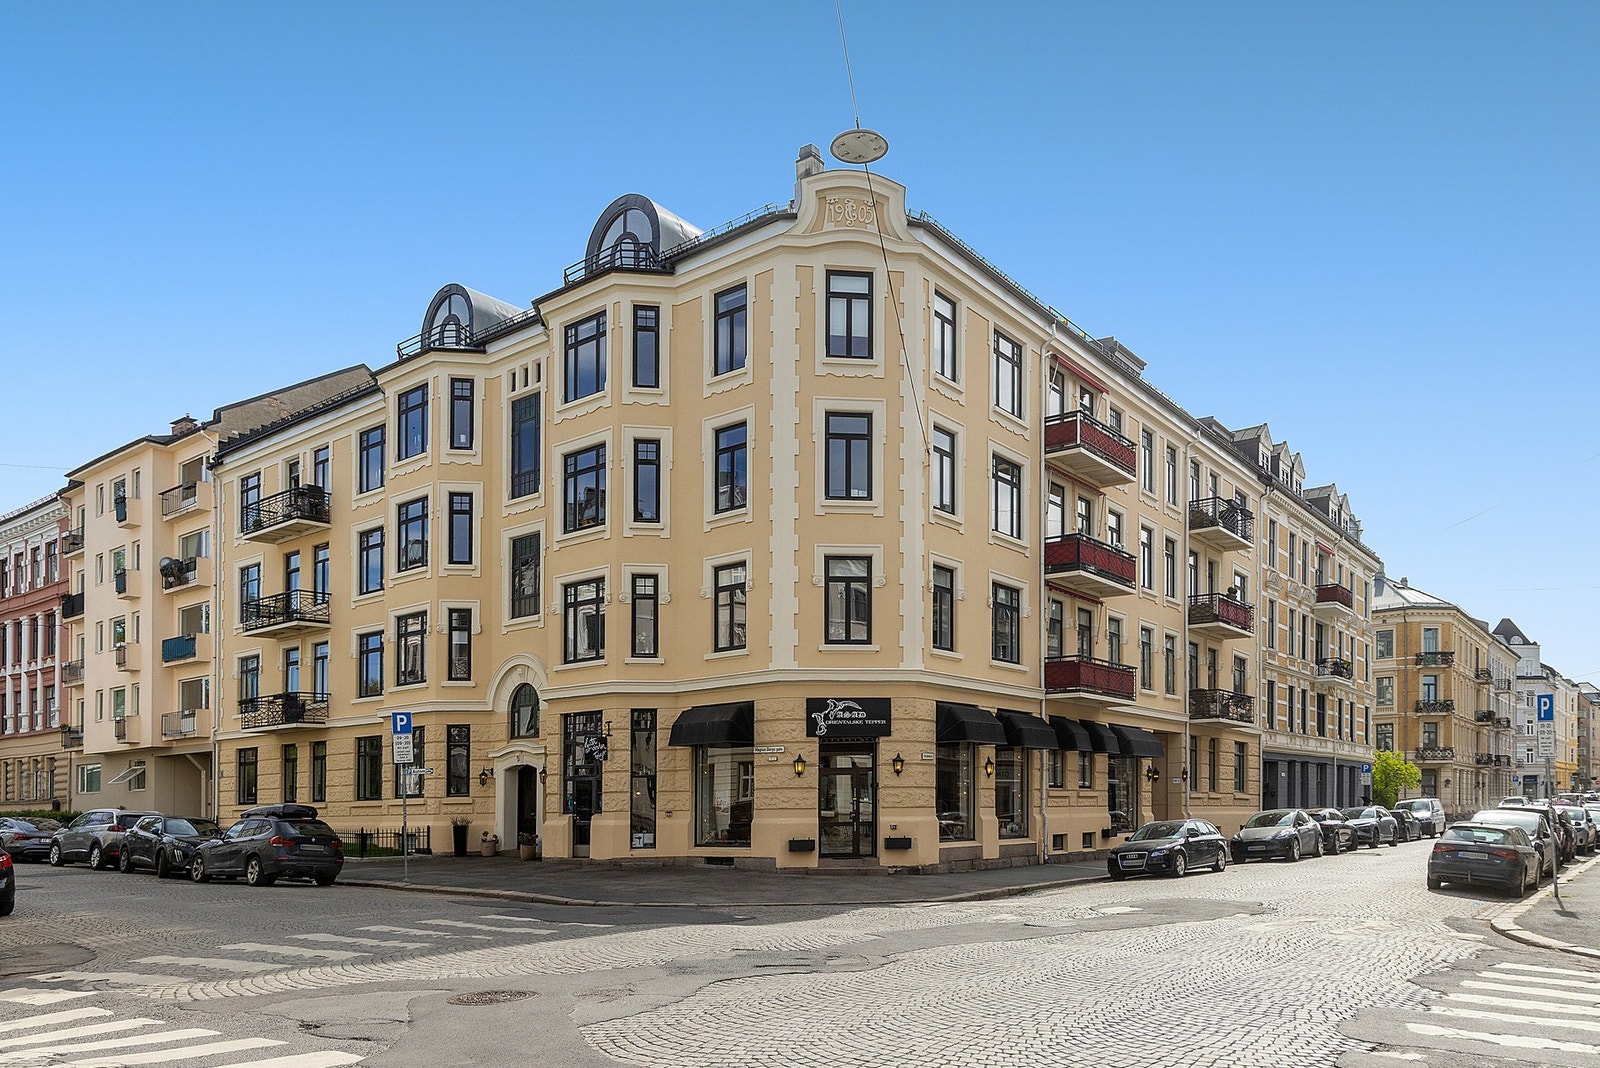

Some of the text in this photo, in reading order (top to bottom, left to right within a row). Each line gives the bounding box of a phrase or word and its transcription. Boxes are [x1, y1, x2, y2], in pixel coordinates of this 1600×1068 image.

[1540, 697, 1550, 718] P
[396, 714, 407, 732] P
[1363, 764, 1370, 773] P
